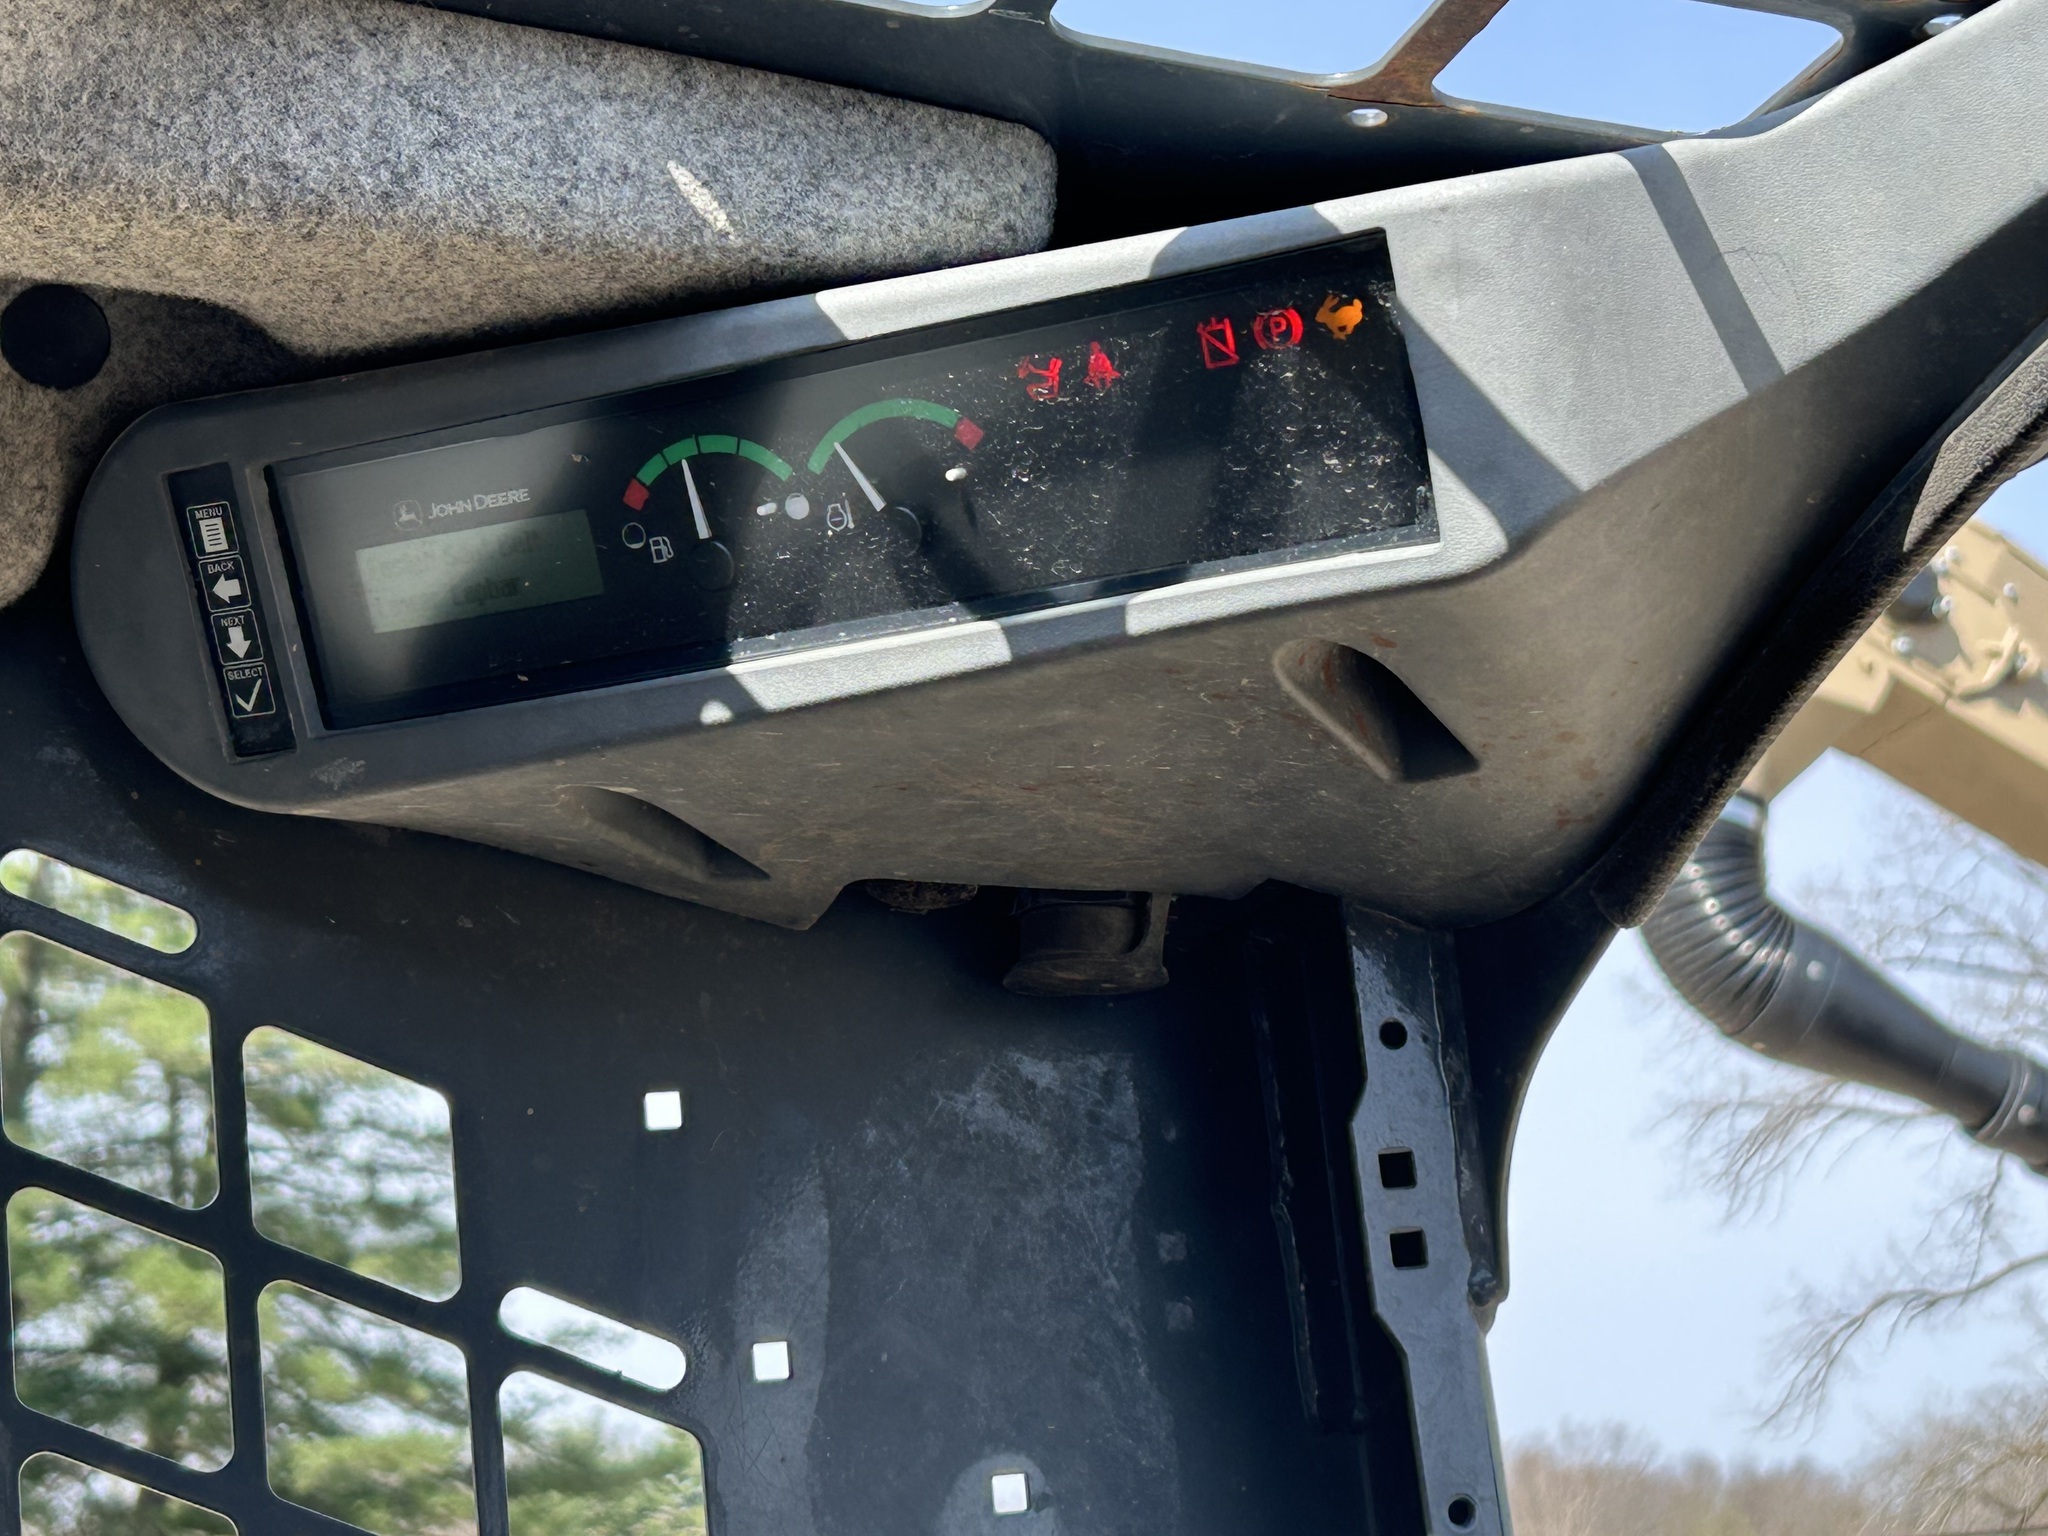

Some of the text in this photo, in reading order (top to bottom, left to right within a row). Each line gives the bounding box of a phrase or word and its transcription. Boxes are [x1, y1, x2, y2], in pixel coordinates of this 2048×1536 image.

[428, 488, 531, 519] JOHN DEERE
[194, 506, 223, 520] MENU
[207, 561, 235, 574] BACK
[220, 615, 245, 627] NEXT
[227, 667, 263, 681] SELECT
